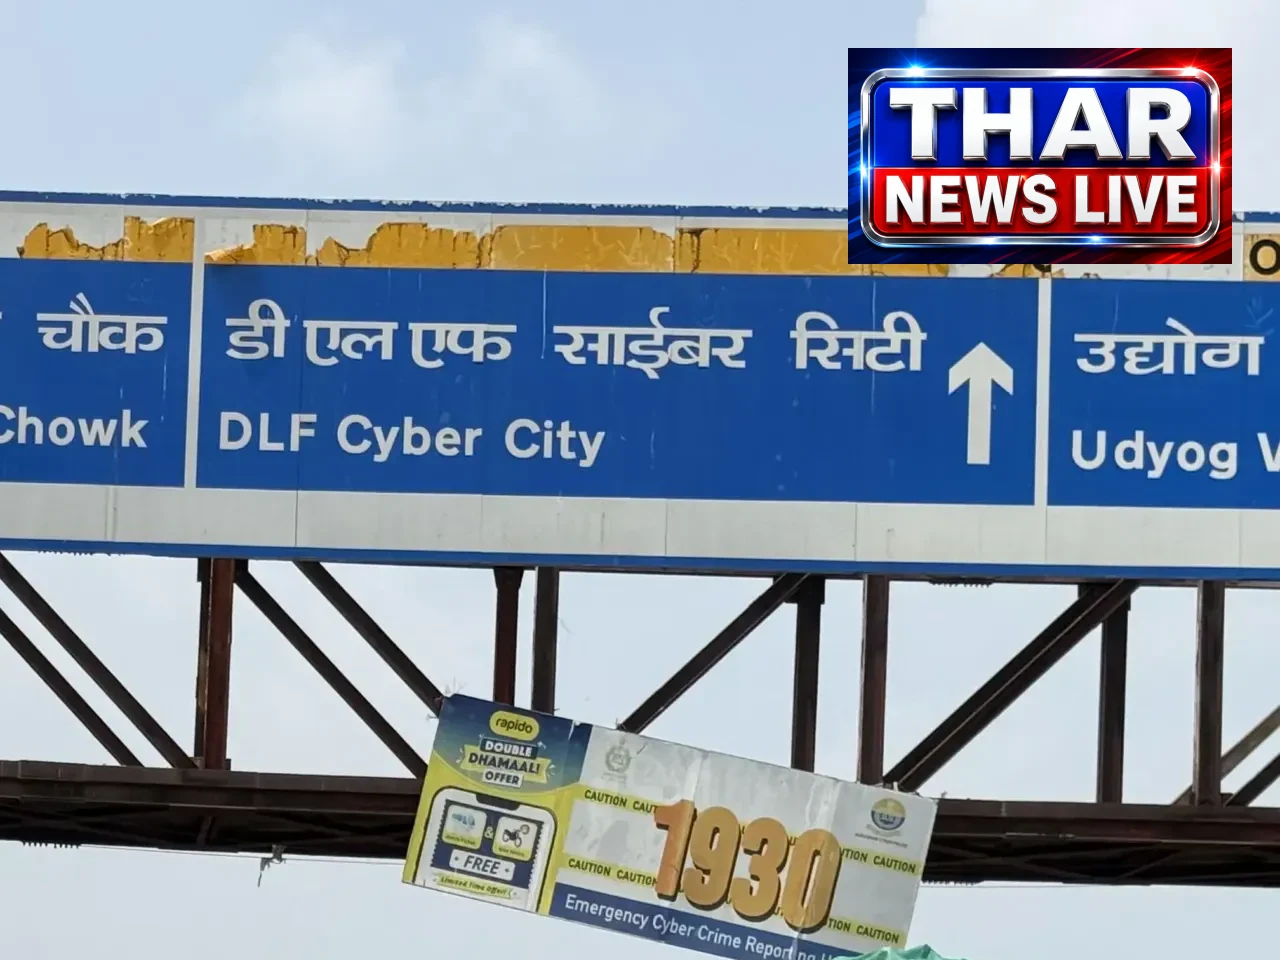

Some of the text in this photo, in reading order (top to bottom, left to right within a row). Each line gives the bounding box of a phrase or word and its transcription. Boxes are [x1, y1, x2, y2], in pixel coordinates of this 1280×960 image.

[36, 292, 168, 354] चौक
[225, 298, 928, 379] डी एल एफ साईबर सिटी
[1074, 317, 1265, 376] उद्योग
[219, 411, 605, 468] DLF Cyber City
[1072, 429, 1238, 480] Udyog
[485, 740, 533, 757] DOUBLE
[495, 717, 533, 734] rapido
[468, 753, 541, 774] DHAMAAL!
[485, 771, 520, 785] OFFER
[584, 789, 628, 808] CAUTION
[873, 855, 917, 873] CAUTION
[464, 855, 501, 875] FREE
[653, 799, 842, 934] 1930
[564, 893, 650, 930] Emergency
[652, 914, 696, 937] Cyber
[697, 928, 741, 949] Crime
[568, 858, 612, 876] CAUTION
[828, 918, 852, 932] TION
[856, 924, 900, 943] CAUTION
